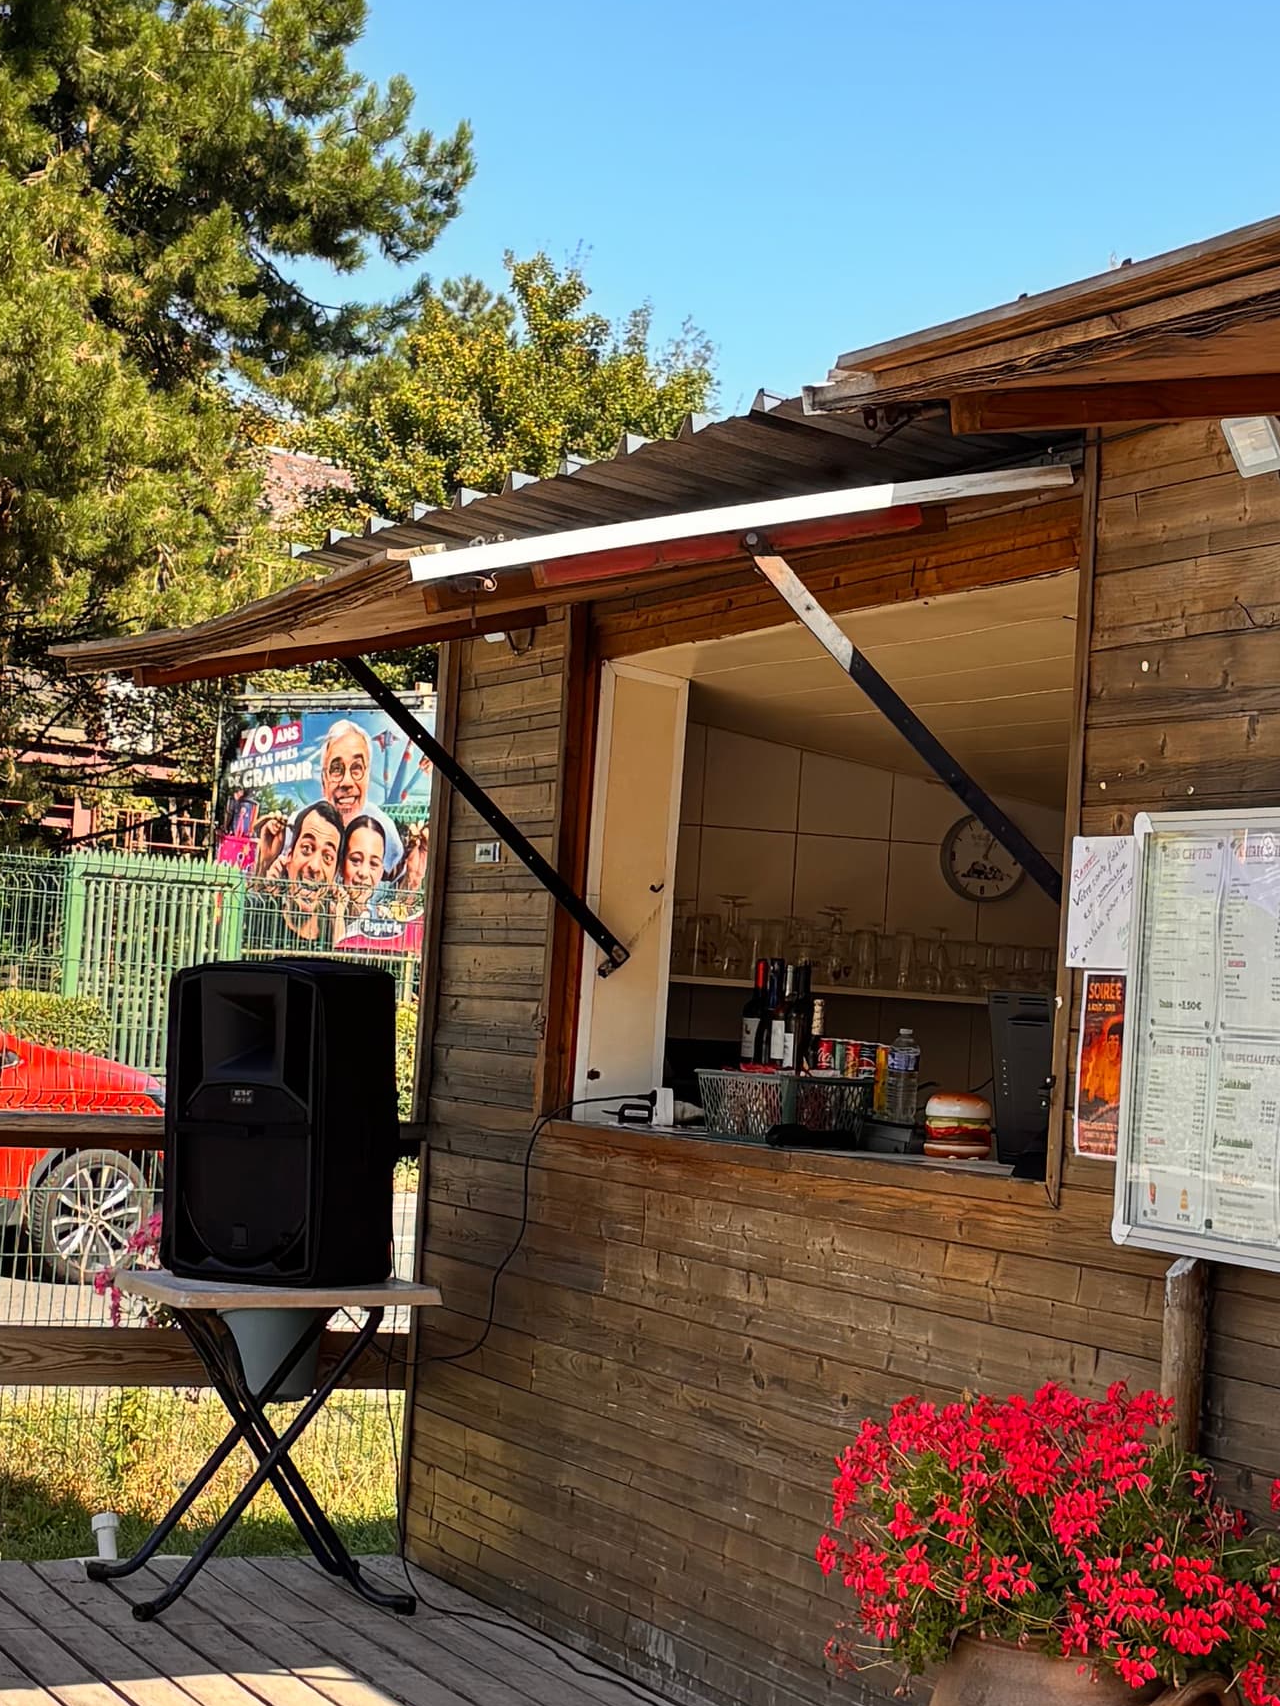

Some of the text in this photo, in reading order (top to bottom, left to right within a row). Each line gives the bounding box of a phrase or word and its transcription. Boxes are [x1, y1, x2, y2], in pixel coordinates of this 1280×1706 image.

[241, 725, 299, 757] 70 ANS
[228, 761, 313, 788] DE GRANDIR
[230, 758, 254, 774] MAIS
[256, 753, 273, 766] PAS
